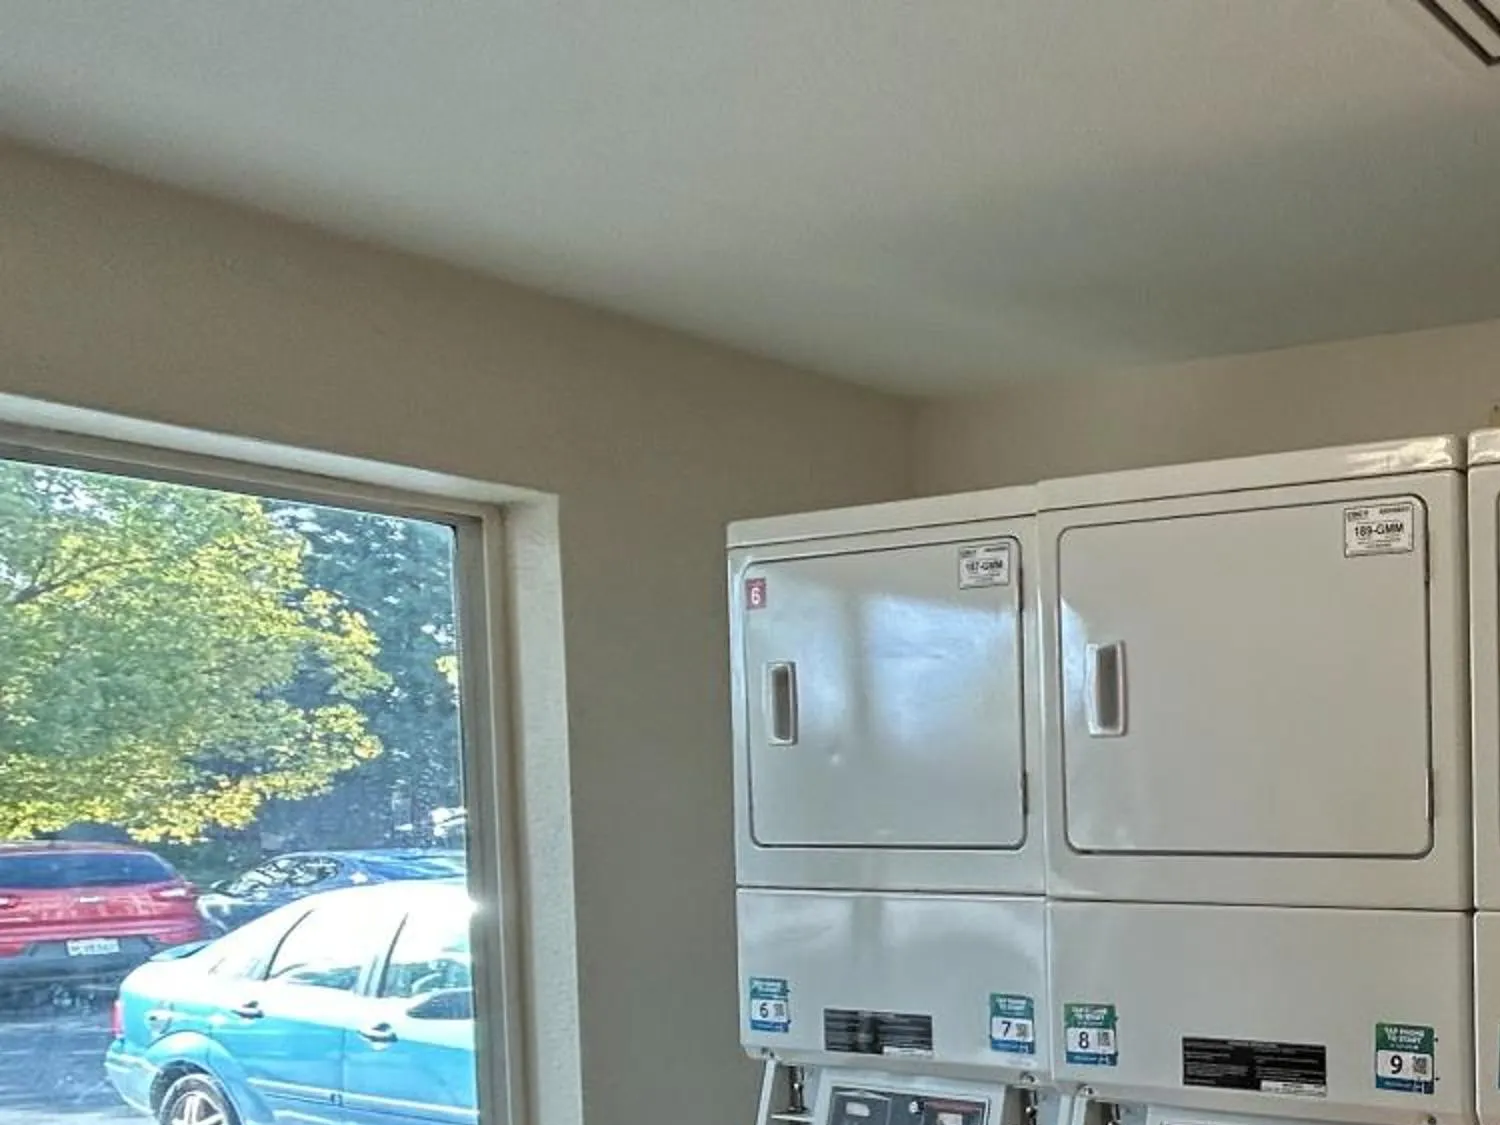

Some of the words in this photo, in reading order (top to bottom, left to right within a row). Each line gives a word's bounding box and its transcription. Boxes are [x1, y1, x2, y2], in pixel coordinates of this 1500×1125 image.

[751, 587, 761, 605] 6
[760, 1002, 769, 1018] 6
[1001, 1020, 1011, 1037] 7
[1079, 1031, 1089, 1049] 8
[1390, 1054, 1402, 1075] 9
